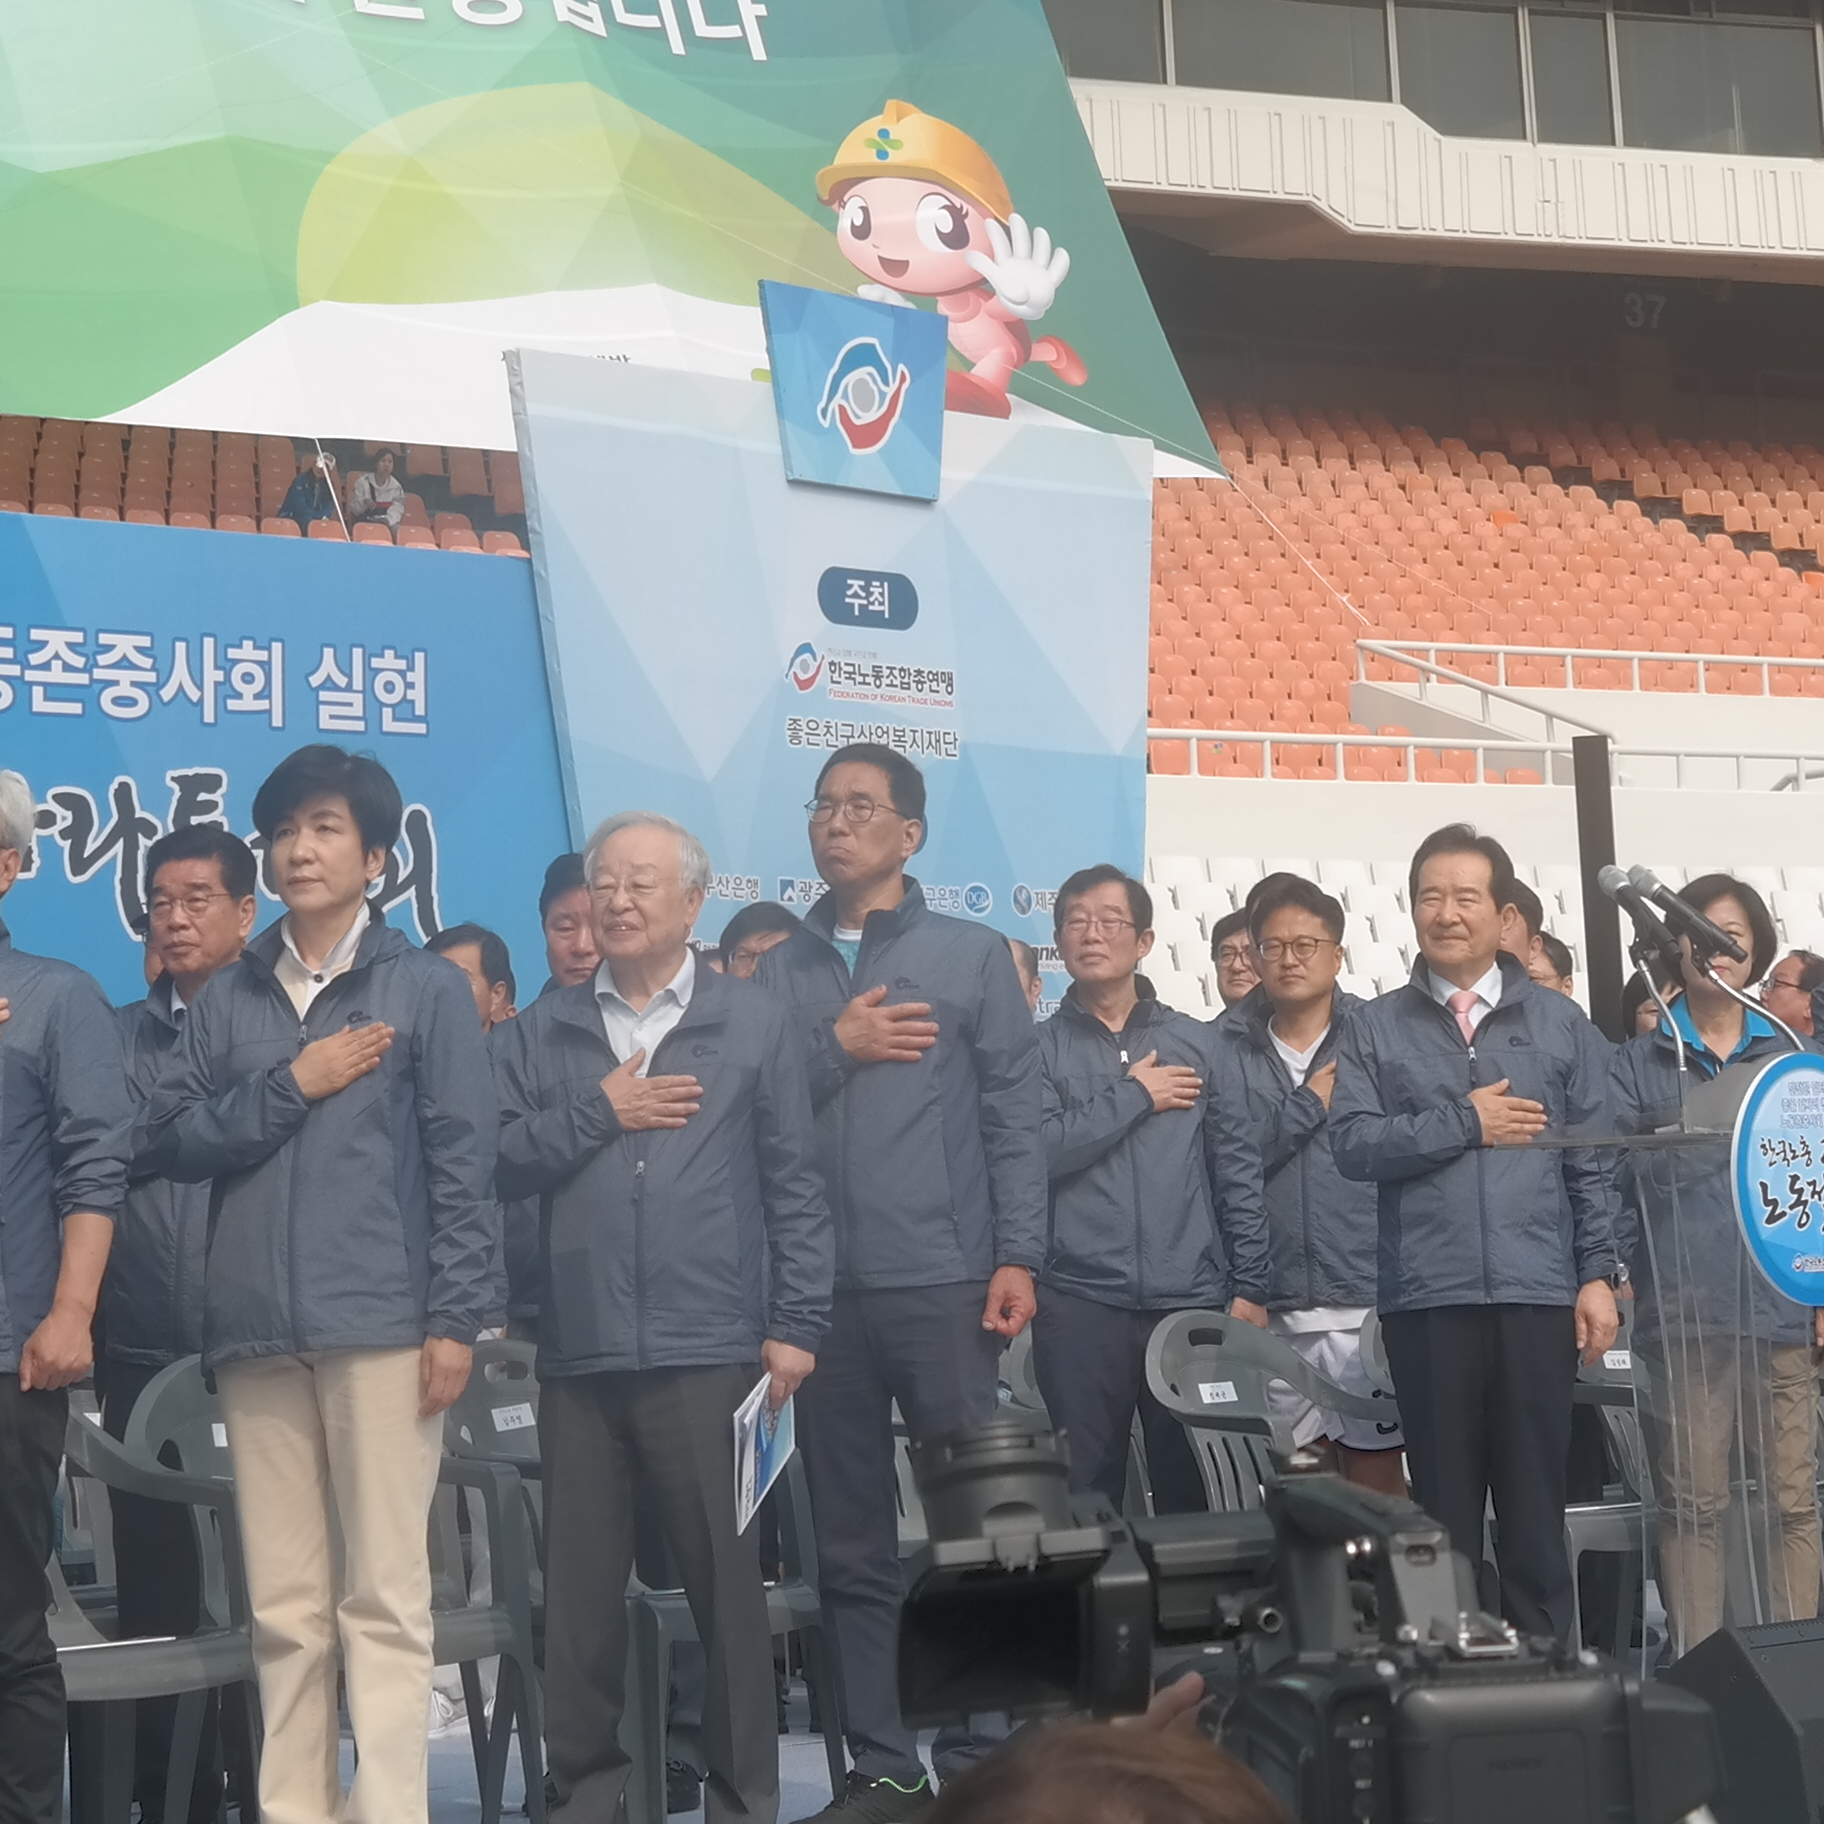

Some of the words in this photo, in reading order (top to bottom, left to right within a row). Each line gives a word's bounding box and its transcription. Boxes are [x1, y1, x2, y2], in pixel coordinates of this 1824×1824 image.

[1624, 292, 1667, 329] 37
[845, 578, 889, 619] 주최
[307, 646, 430, 738] 실현
[827, 659, 954, 696] 한국노동조합총연맹
[829, 688, 870, 701] FEDERATION
[879, 692, 907, 704] KOREAN
[907, 695, 928, 706] TRADE
[929, 698, 954, 708] UNIONS
[967, 890, 988, 906] DGB
[1759, 1135, 1813, 1168] 한국노총
